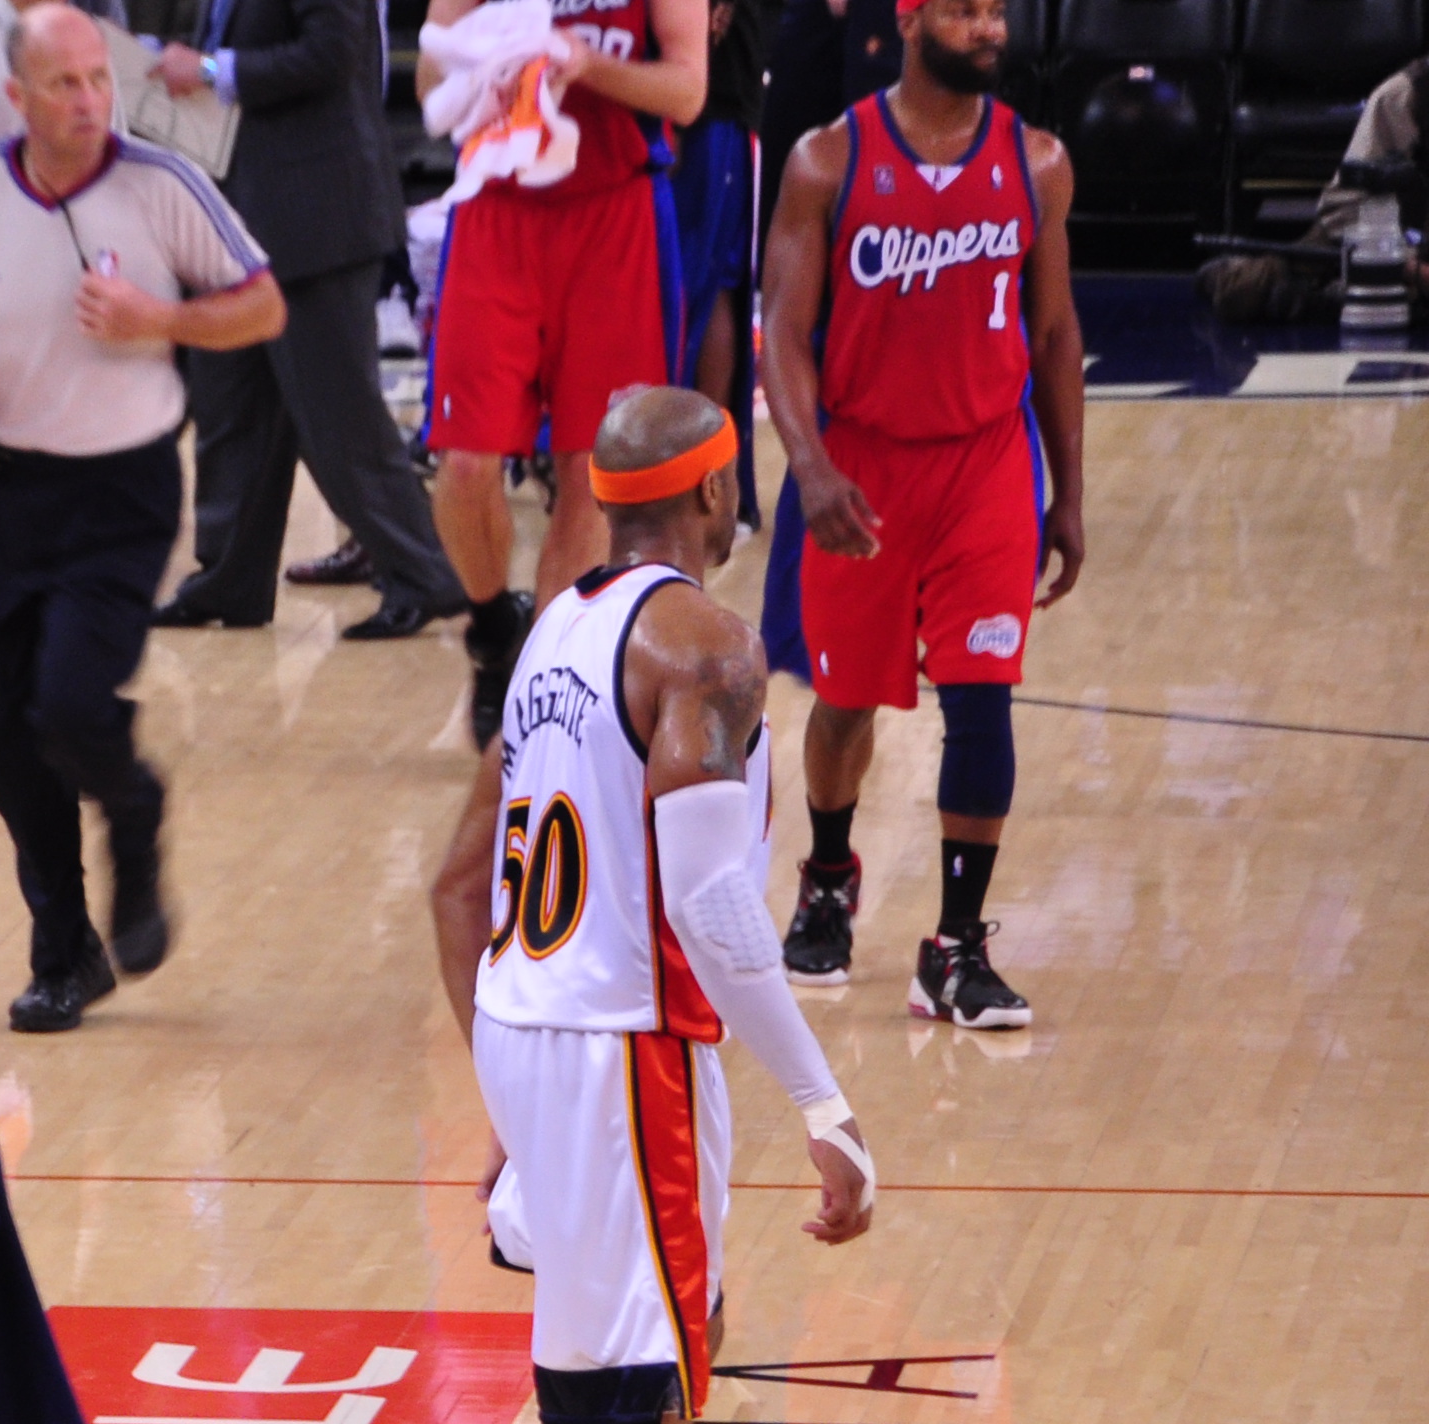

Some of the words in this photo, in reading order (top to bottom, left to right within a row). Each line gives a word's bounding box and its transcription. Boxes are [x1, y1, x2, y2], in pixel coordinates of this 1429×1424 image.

[850, 217, 1020, 295] Clippers
[988, 271, 1010, 330] 1
[489, 790, 588, 967] 50
